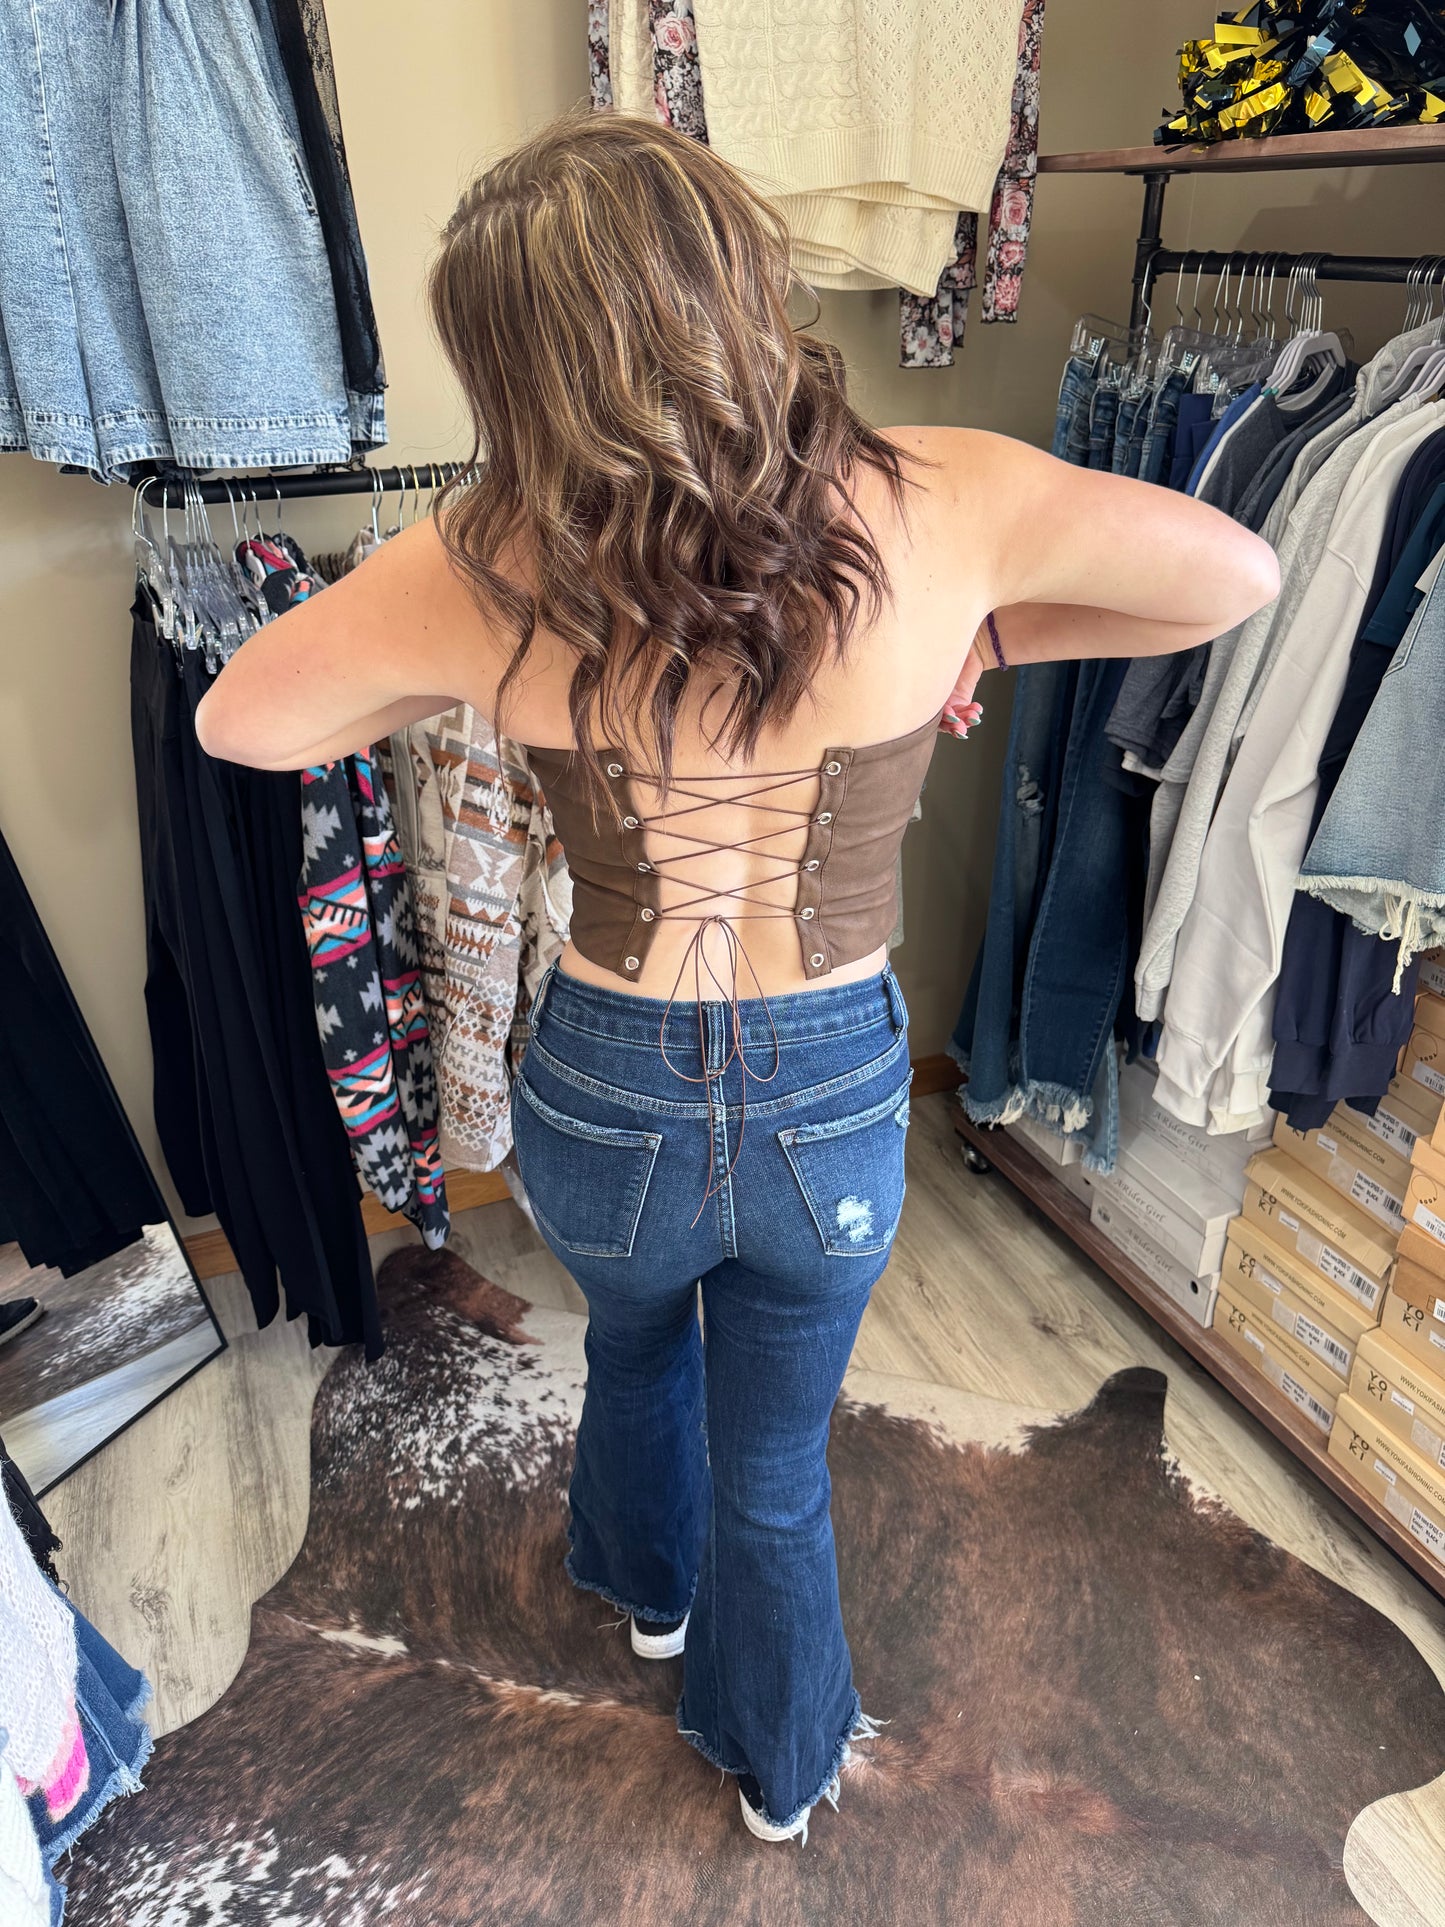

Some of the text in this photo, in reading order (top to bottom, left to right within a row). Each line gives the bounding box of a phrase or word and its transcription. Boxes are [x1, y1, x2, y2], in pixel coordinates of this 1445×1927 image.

[1162, 1117, 1187, 1137] Rider
[1188, 1134, 1209, 1153] Girl
[1145, 1201, 1167, 1223] Girl
